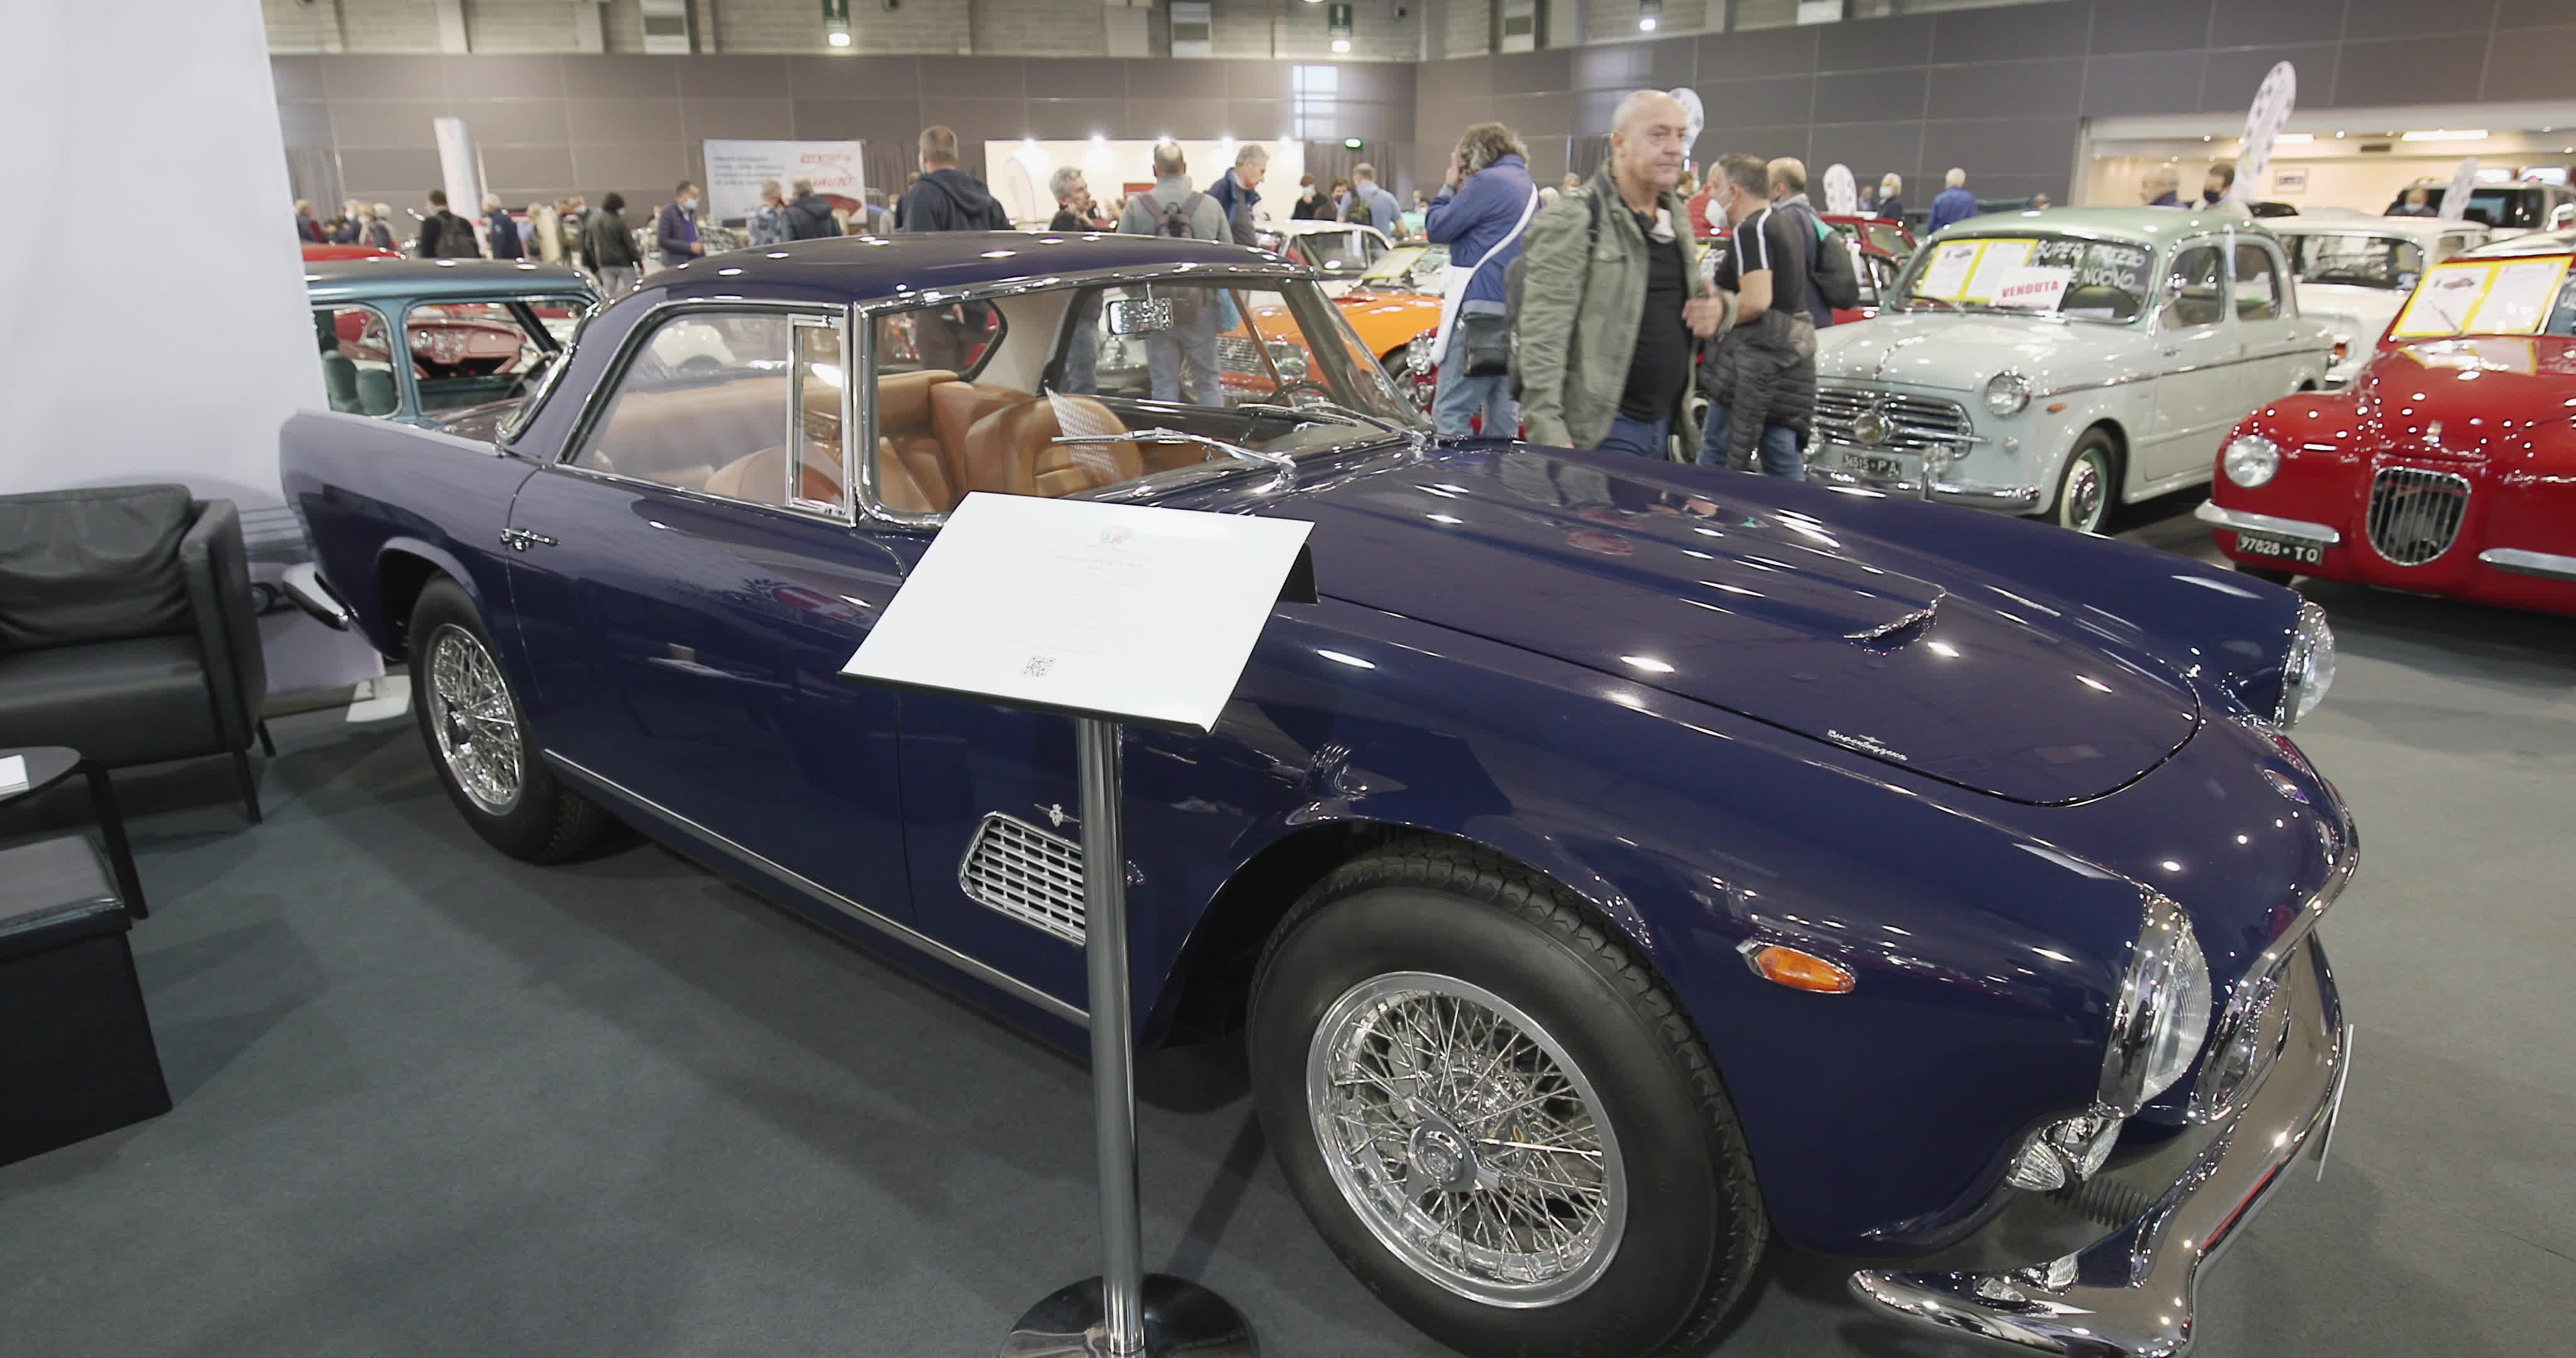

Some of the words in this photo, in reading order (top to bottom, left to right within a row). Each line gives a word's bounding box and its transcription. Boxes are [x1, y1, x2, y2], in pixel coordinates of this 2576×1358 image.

[2037, 240, 2085, 258] SUPER
[2002, 280, 2058, 297] VENDUTA
[2240, 536, 2280, 555] 97828
[2296, 546, 2318, 562] TO
